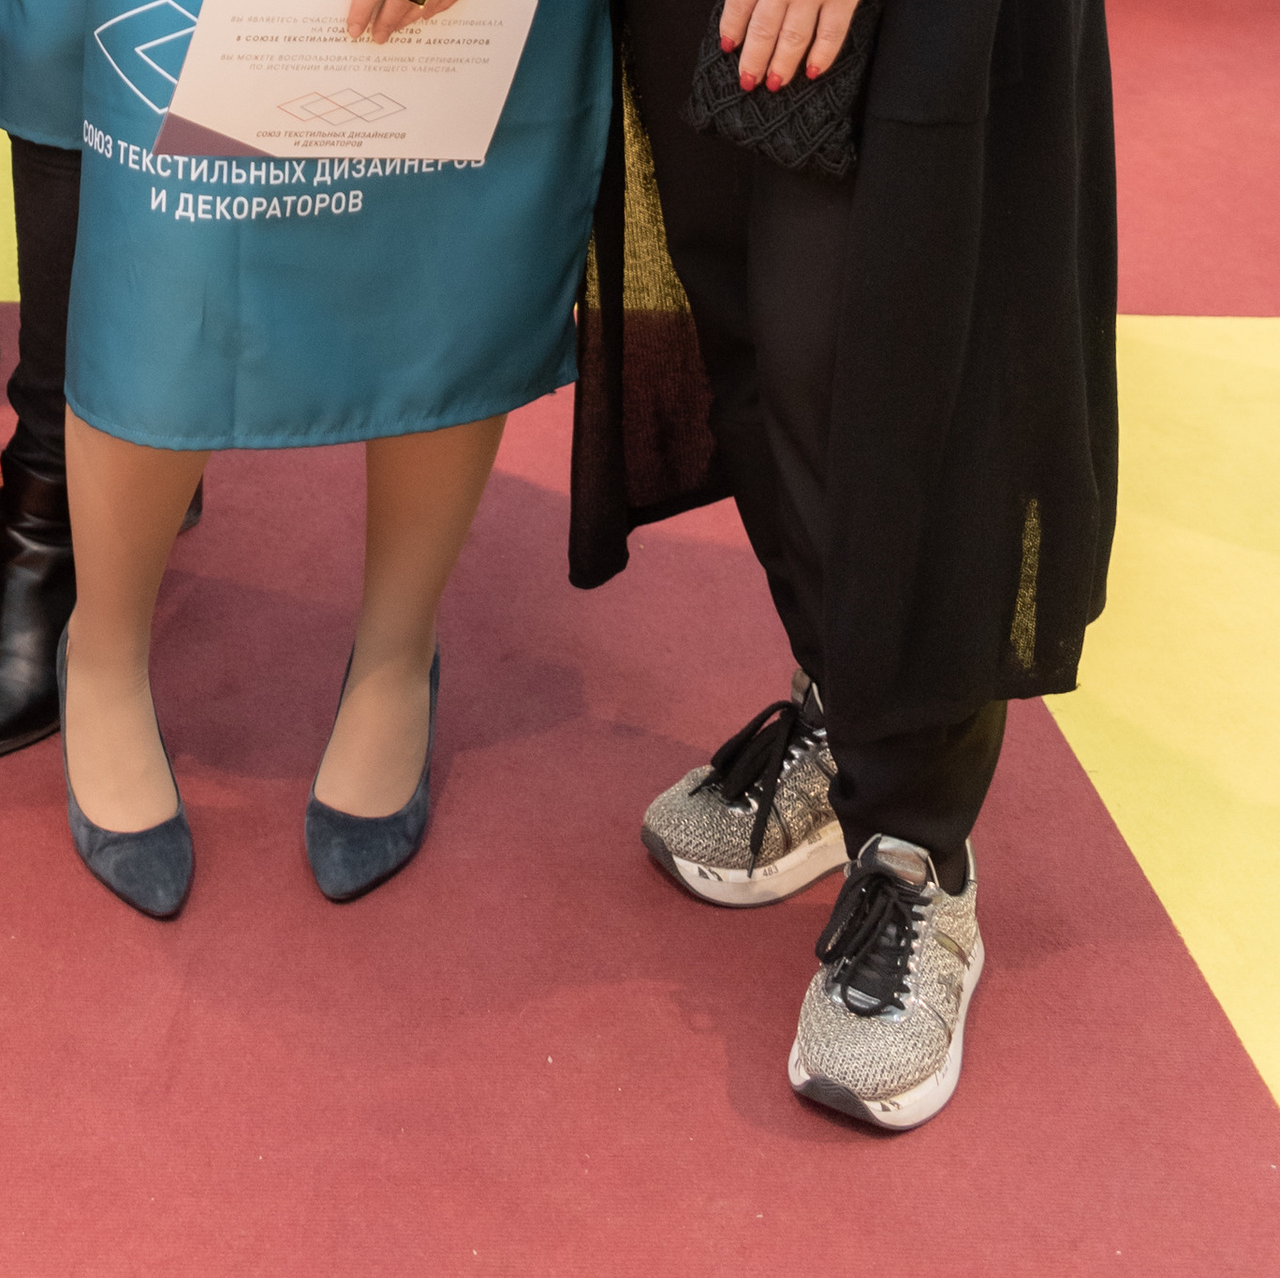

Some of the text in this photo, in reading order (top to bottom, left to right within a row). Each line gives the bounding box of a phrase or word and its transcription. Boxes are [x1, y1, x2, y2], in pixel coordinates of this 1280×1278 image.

[245, 35, 279, 43] СОЮЗЕ
[283, 35, 347, 43] ТЕКСТИЛЬНЫХ
[425, 37, 490, 46] ДЕКОРАТОРОВ
[256, 130, 407, 140] СОЮЗ ТЕКСТИЛЬНЫХ ДИЗАЙНЕРОВ
[293, 139, 364, 148] И ДЕКОРАТОРОВ
[83, 119, 113, 159] СОЮЗ
[117, 139, 307, 185] ТЕКСТИЛЬНЫХ
[150, 186, 363, 222] И ДЕКОРАТОРОВ
